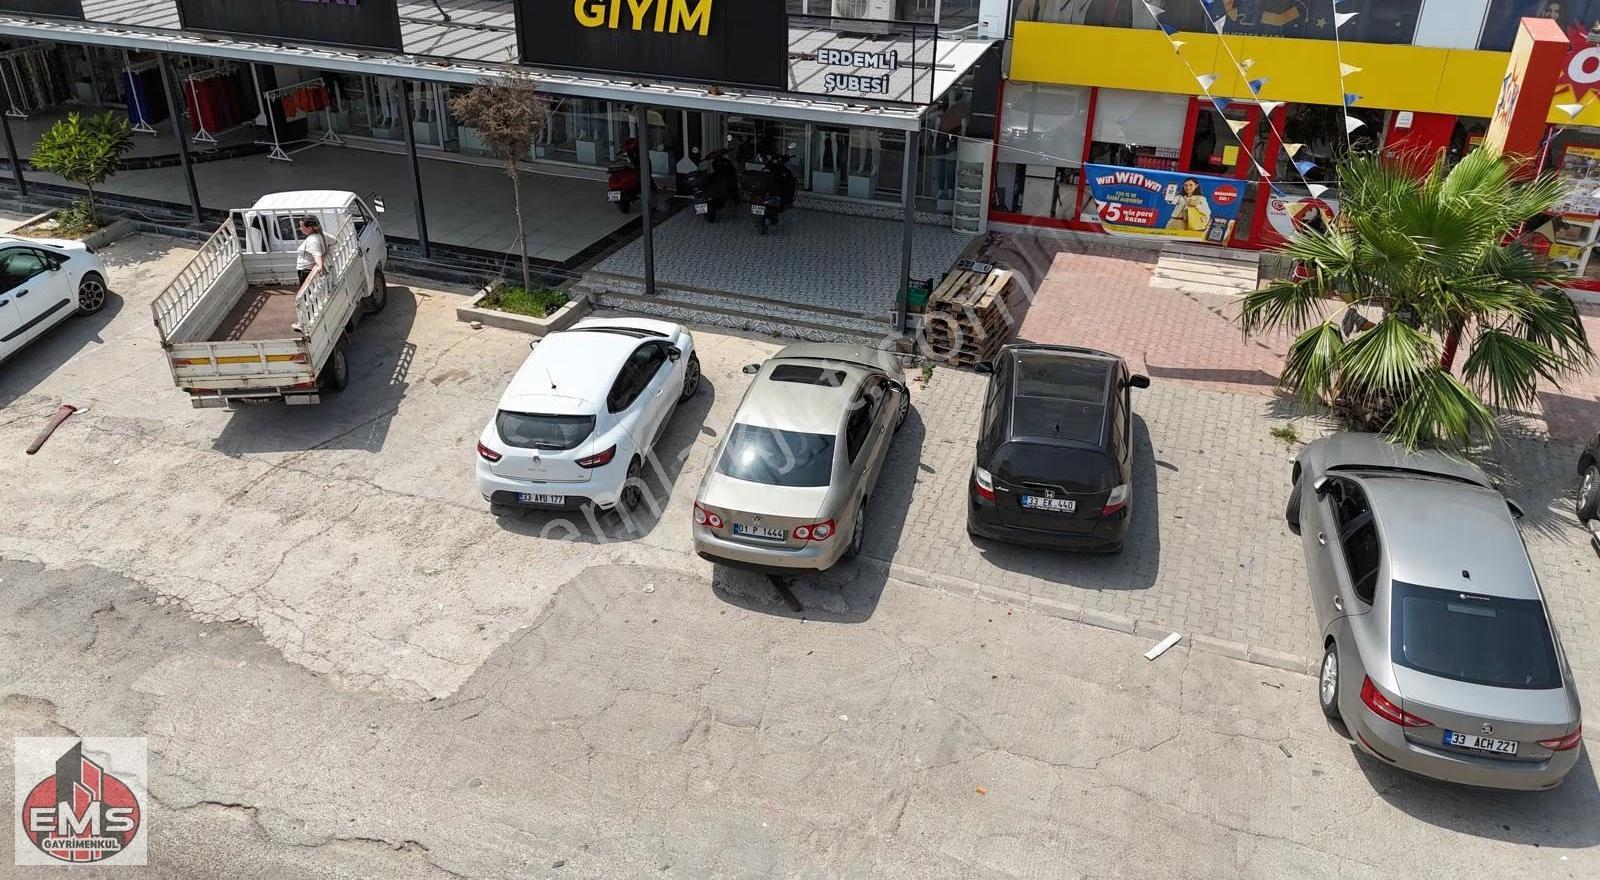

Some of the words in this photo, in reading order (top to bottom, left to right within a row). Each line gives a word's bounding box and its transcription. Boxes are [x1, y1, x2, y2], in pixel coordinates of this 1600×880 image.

[817, 48, 898, 71] ERDEMLİ
[825, 73, 889, 94] ŞUBESİ
[1124, 213, 1147, 224] kazan
[523, 492, 531, 501] 33
[550, 495, 563, 503] 177
[1028, 496, 1038, 505] 33
[1043, 499, 1053, 507] EK
[1057, 500, 1073, 509] 440
[738, 524, 748, 533] 01
[752, 526, 759, 534] P
[763, 528, 783, 537] 1444
[1452, 733, 1466, 745] 33
[1473, 737, 1494, 750] ACH
[1496, 741, 1516, 752] 221
